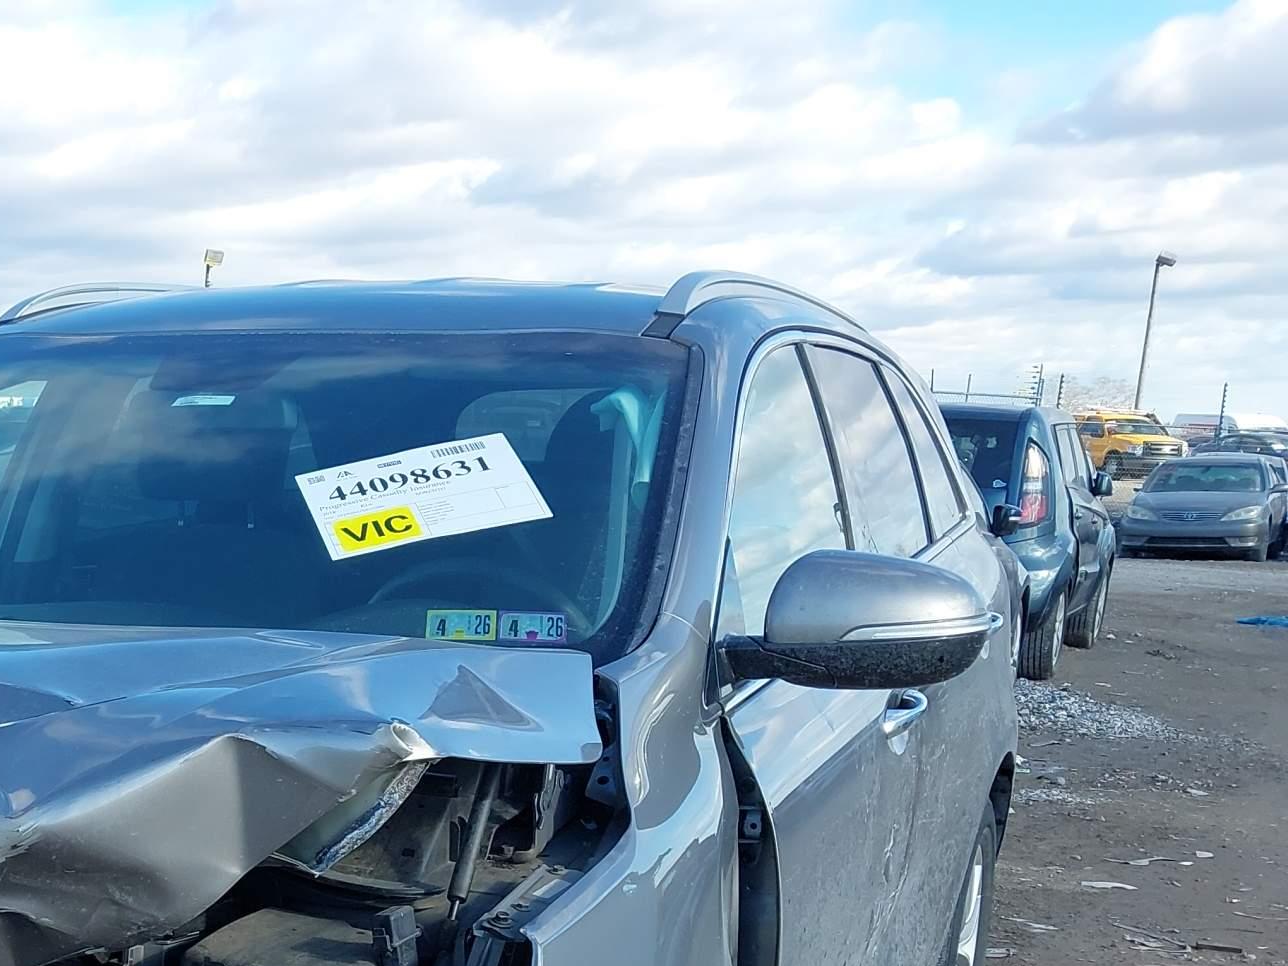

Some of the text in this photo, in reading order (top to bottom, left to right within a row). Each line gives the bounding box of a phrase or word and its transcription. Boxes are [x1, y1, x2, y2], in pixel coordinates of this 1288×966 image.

[329, 456, 492, 501] 44098631
[342, 515, 414, 542] VIC
[436, 615, 491, 637] 4 26
[508, 617, 563, 638] 4 26
